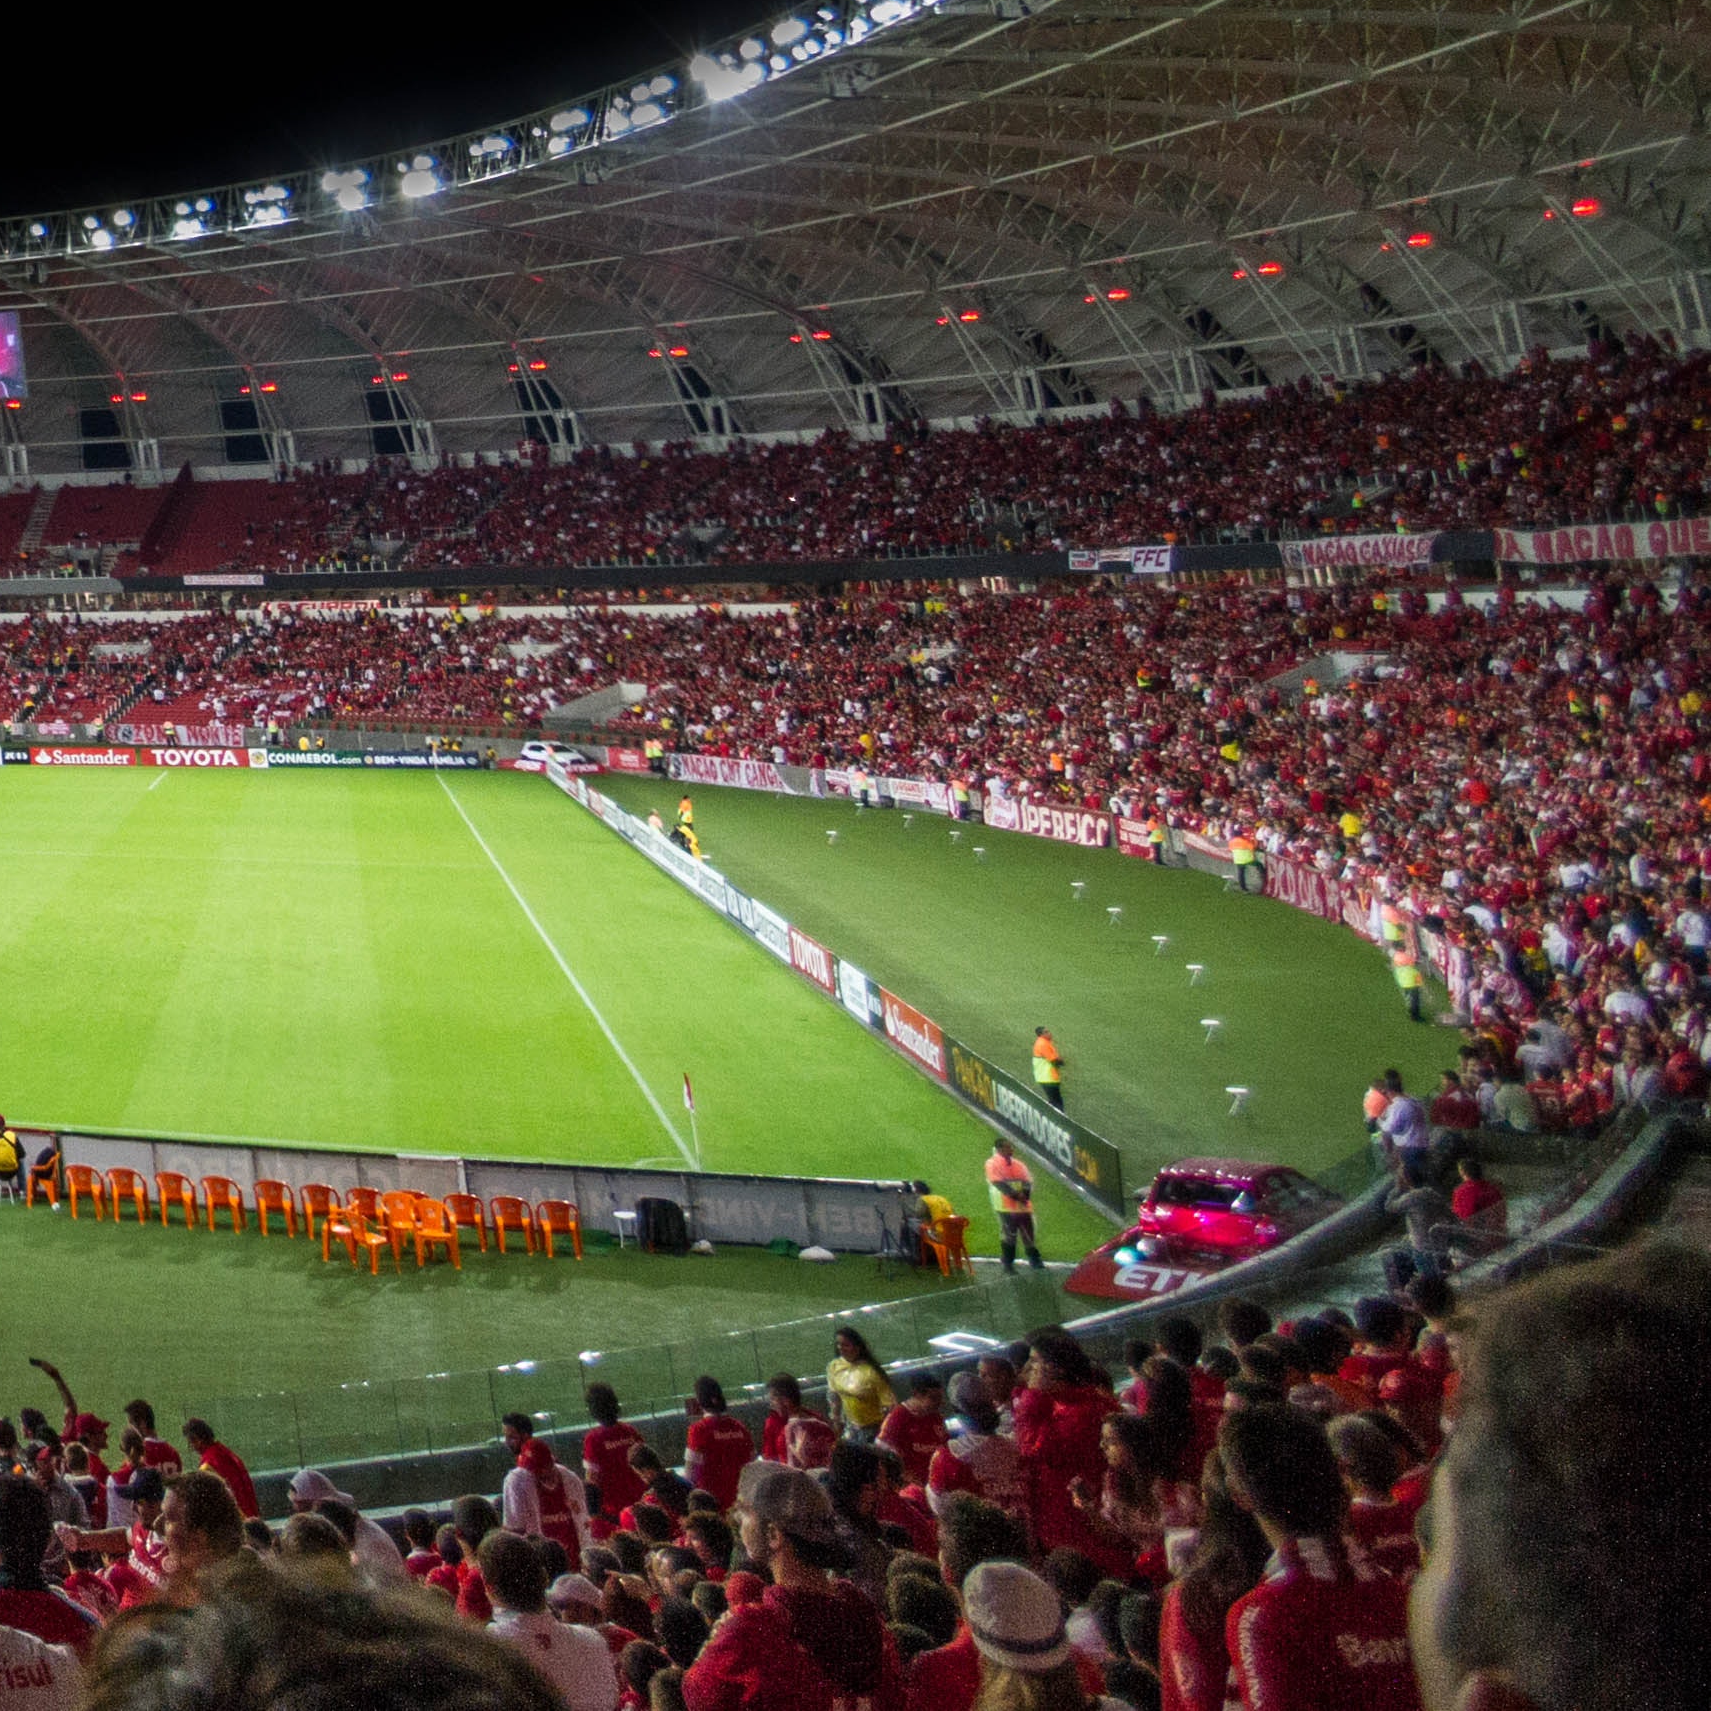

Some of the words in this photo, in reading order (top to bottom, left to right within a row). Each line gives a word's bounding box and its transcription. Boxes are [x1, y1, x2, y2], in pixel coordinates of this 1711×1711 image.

[53, 749, 130, 765] Santander
[151, 749, 239, 766] TOYOTA
[268, 752, 362, 764] CONMEBOL.com
[894, 1017, 942, 1073] Santander
[991, 1079, 1072, 1167] LIBERTADORES
